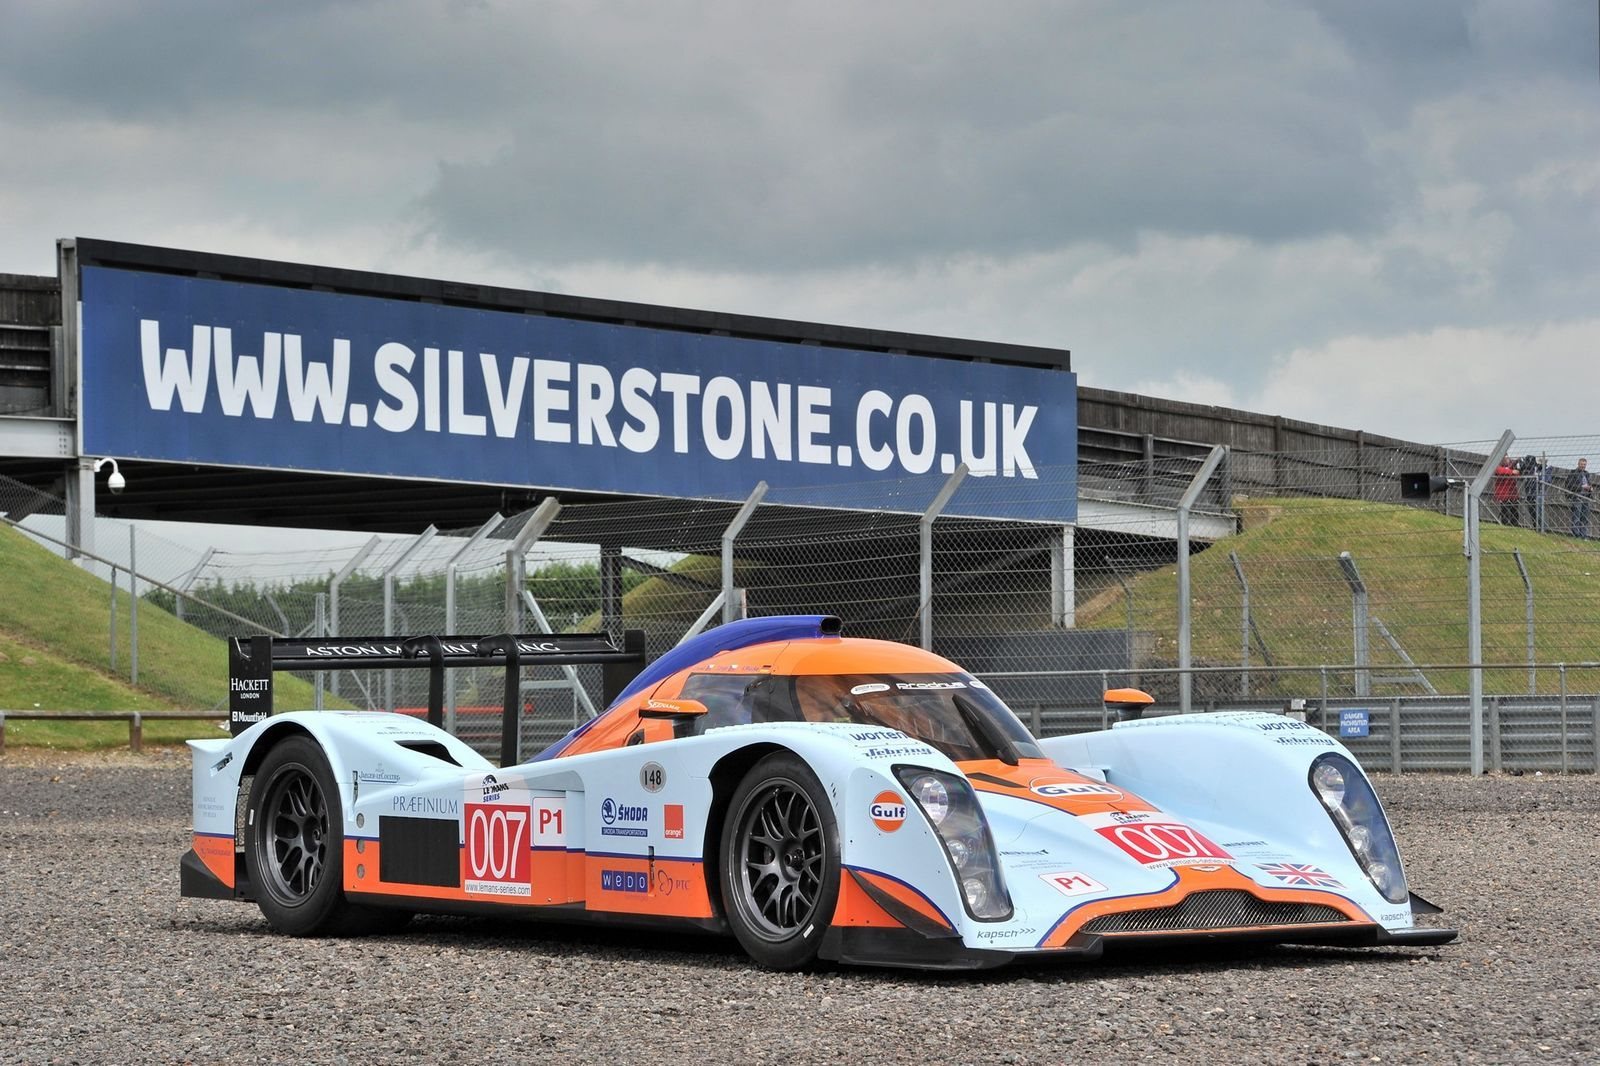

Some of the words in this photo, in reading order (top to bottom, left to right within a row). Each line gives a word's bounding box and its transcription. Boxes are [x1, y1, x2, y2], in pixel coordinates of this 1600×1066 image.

[139, 319, 1040, 480] WWW.SILVERSTONE.CO.UK
[305, 645, 381, 656] ASTON
[231, 677, 269, 691] HACKETT
[240, 692, 260, 700] LONDON
[1256, 720, 1311, 731] worten
[850, 729, 909, 742] worten
[863, 746, 934, 757] Sebring
[643, 769, 662, 786] 148
[482, 786, 490, 795] LE
[490, 782, 510, 793] MANS
[1036, 784, 1115, 795] Gulf
[482, 793, 501, 803] SERIES
[871, 804, 907, 819] Gulf
[539, 808, 563, 835] P1
[665, 829, 681, 838] orange
[470, 808, 528, 879] 007
[1114, 824, 1215, 860] 007
[465, 882, 531, 895] www.lemans-series.com
[1054, 875, 1093, 890] P1
